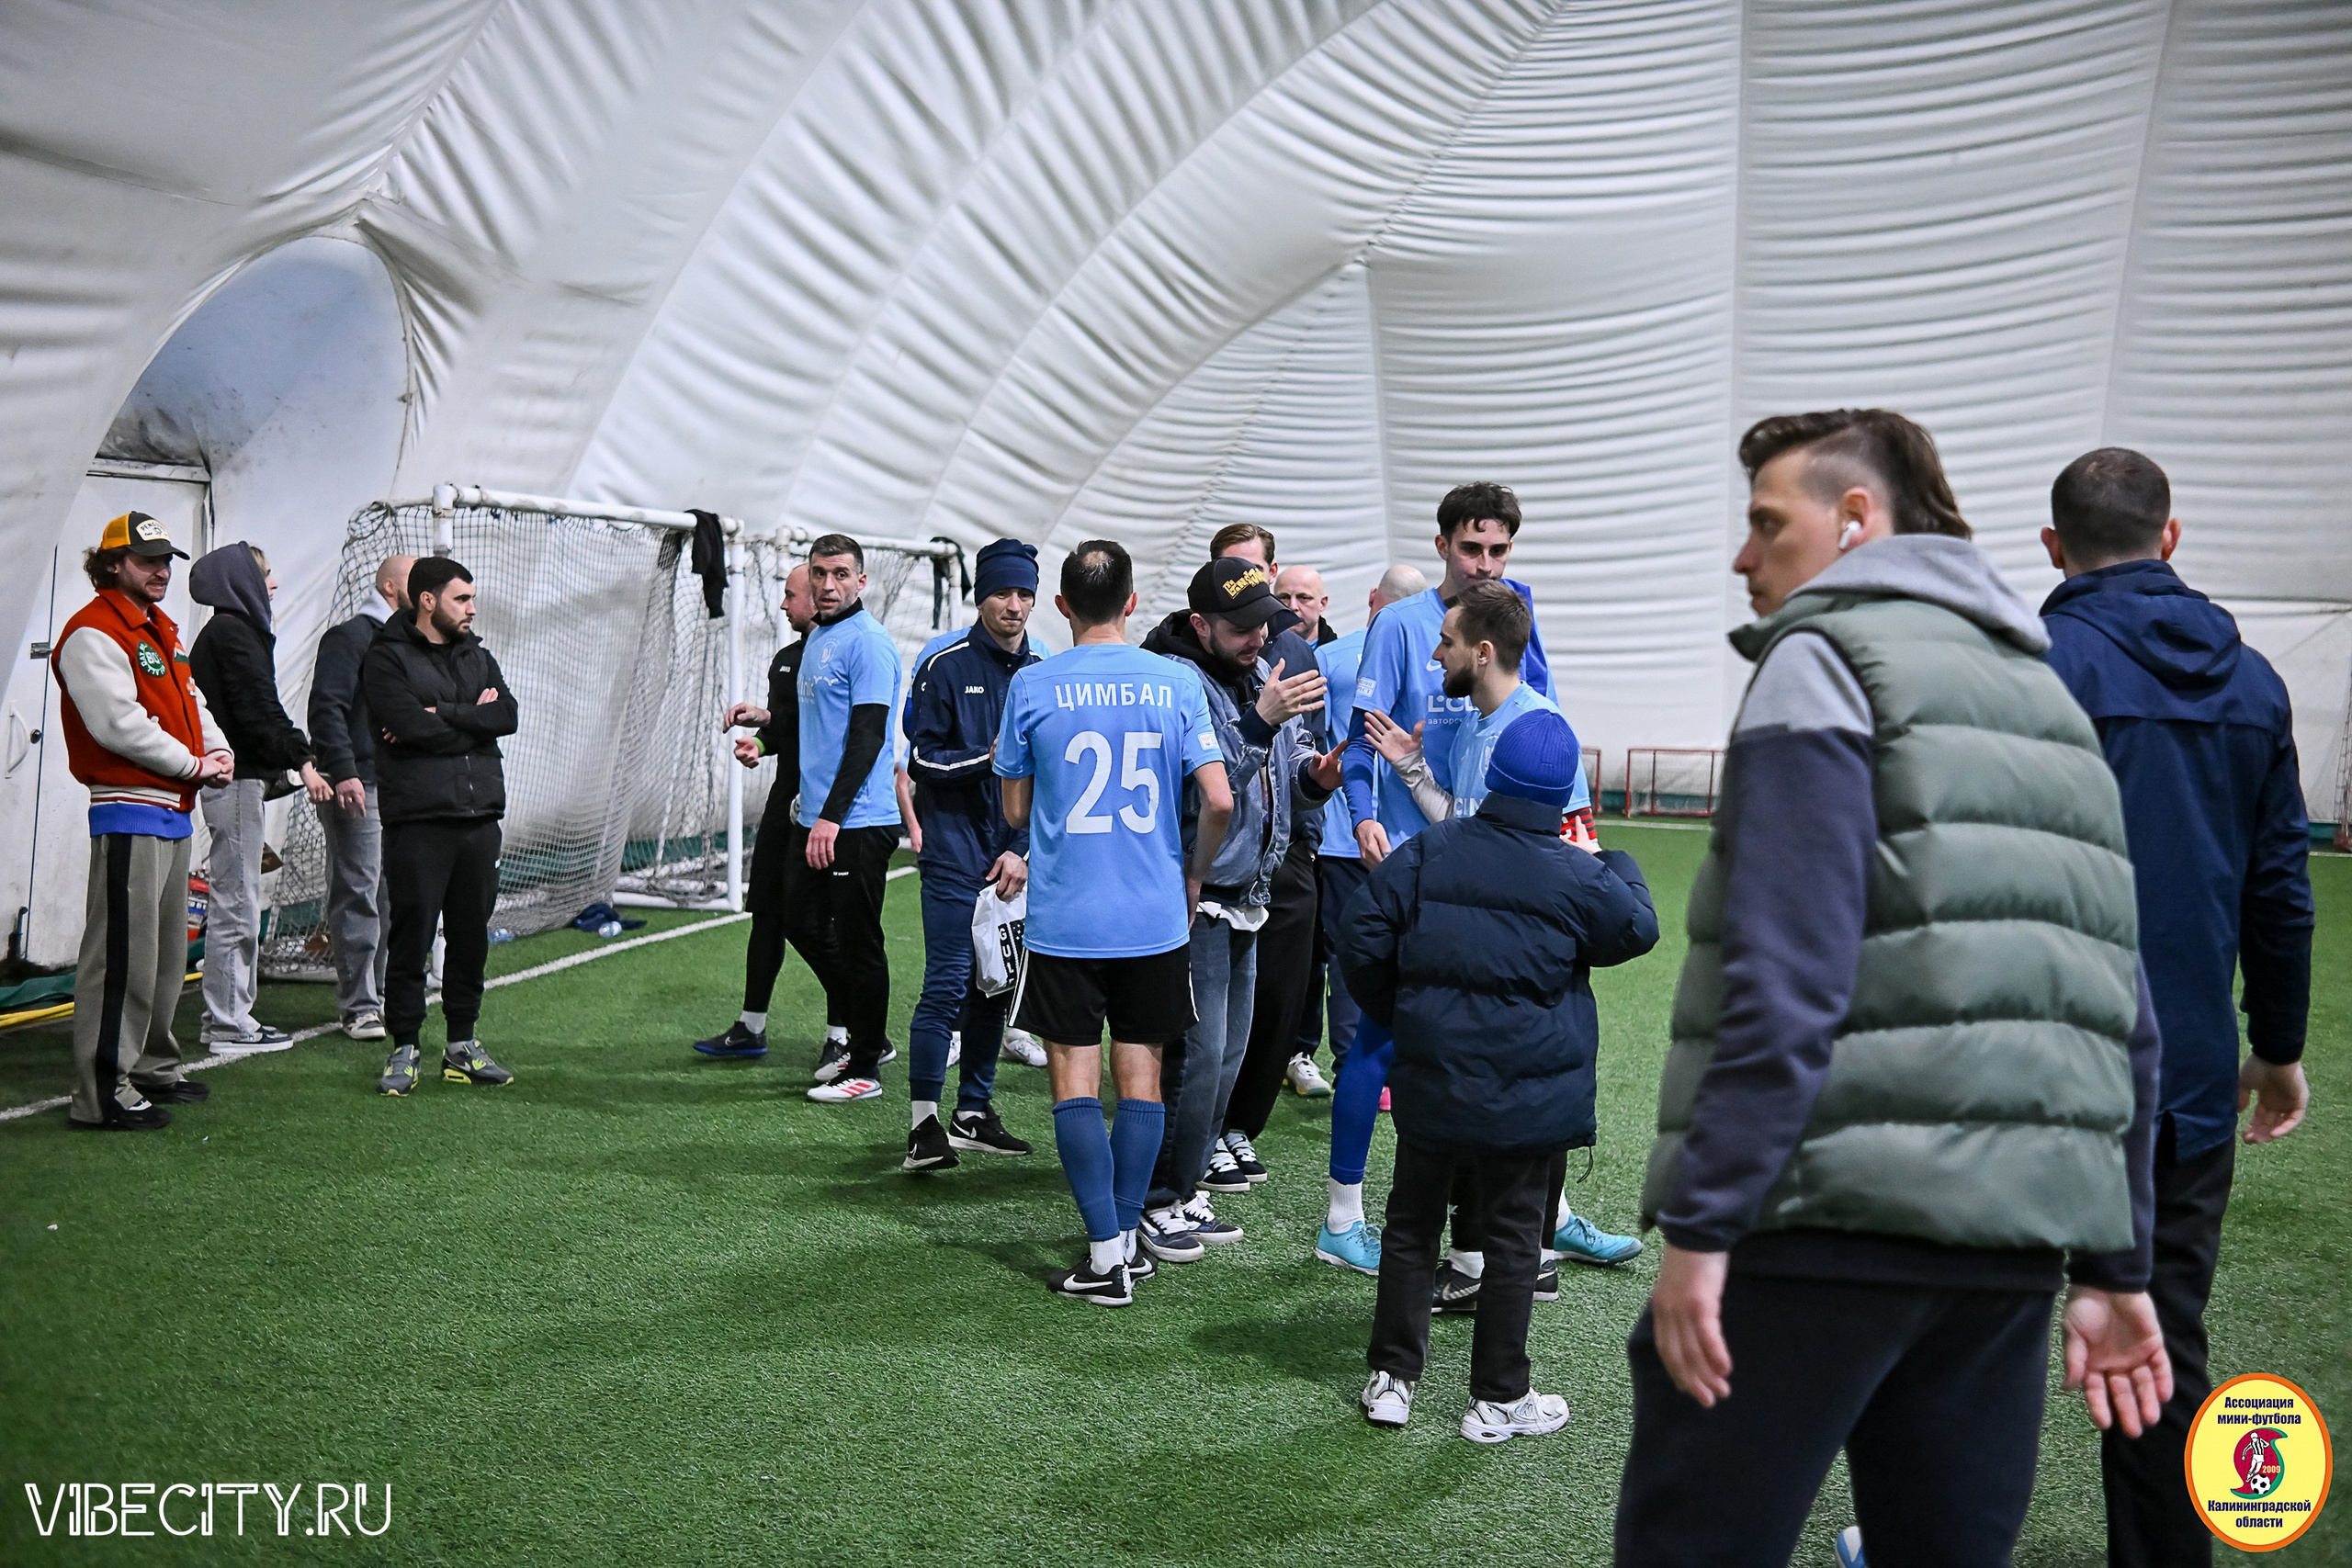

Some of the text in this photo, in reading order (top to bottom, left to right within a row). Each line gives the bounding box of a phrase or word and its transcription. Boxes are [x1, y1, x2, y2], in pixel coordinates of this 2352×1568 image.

[965, 685, 984, 694] JAKO
[1056, 683, 1171, 711] ЦИМБАЛ
[1064, 731, 1163, 834] 25
